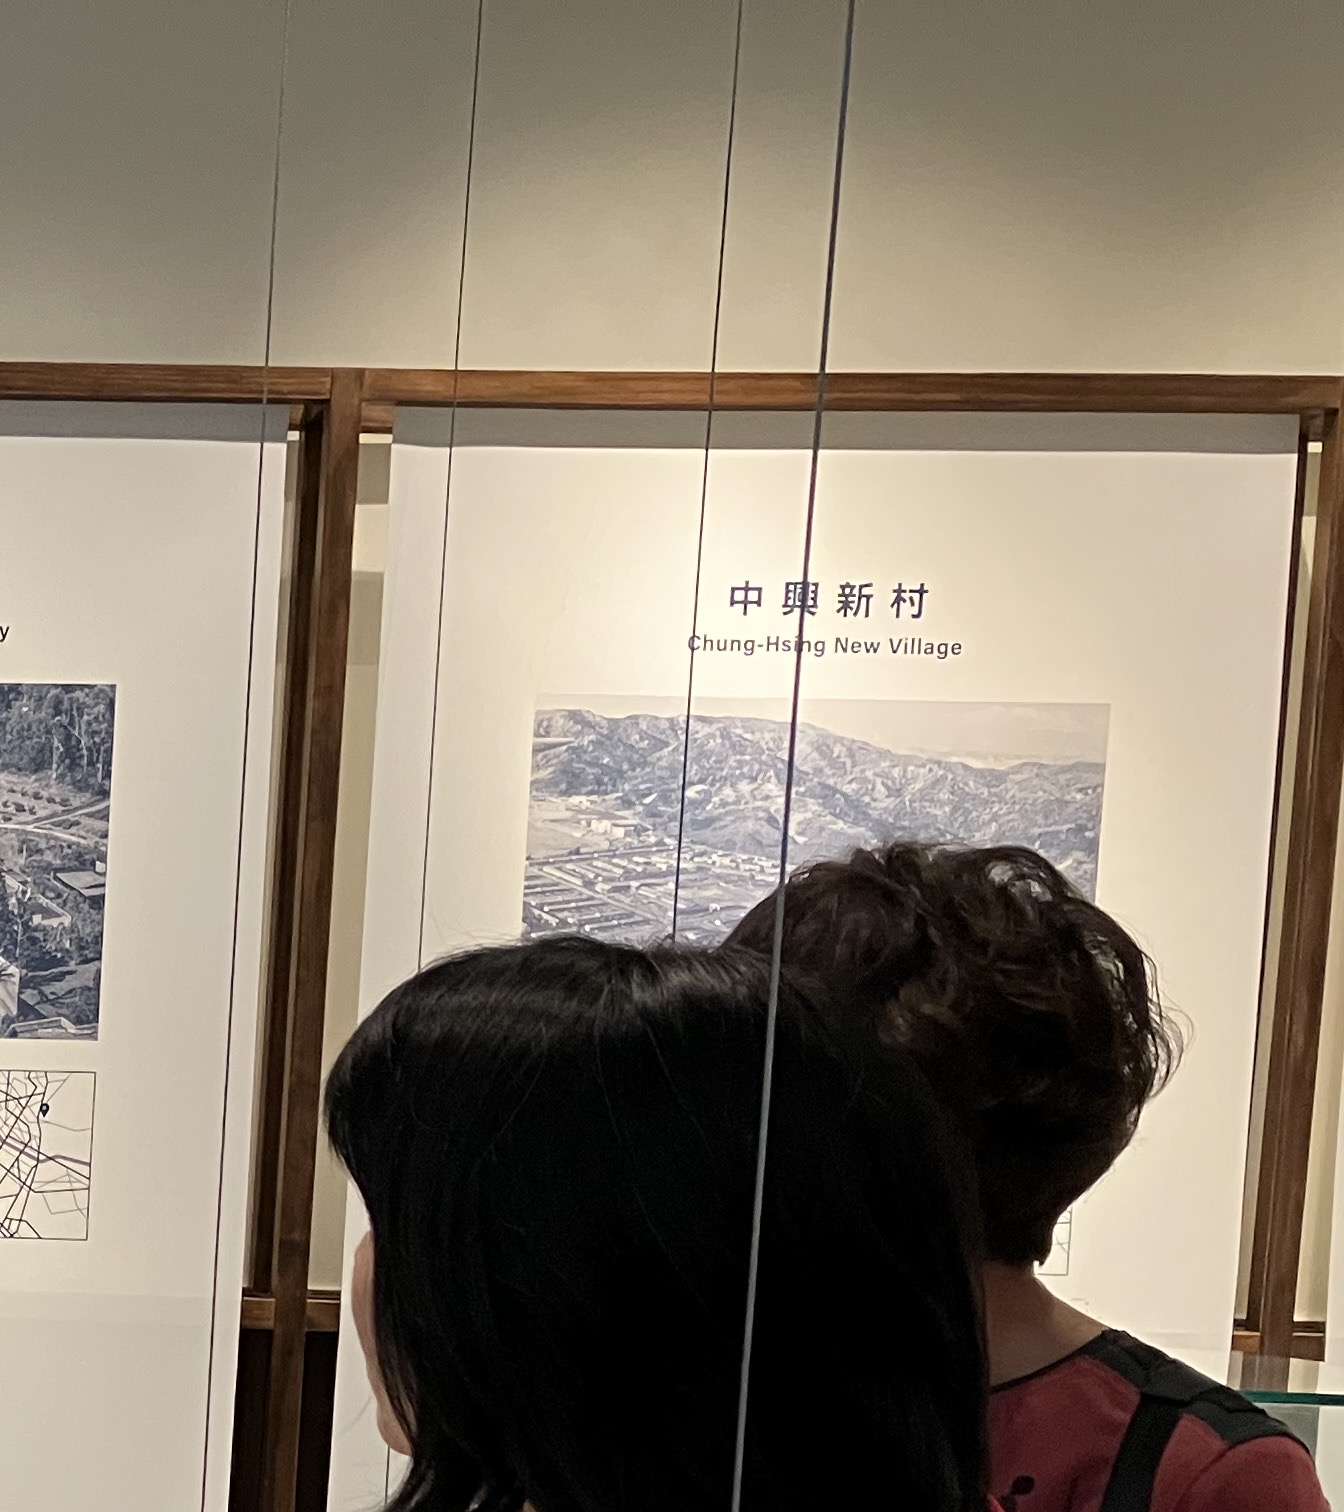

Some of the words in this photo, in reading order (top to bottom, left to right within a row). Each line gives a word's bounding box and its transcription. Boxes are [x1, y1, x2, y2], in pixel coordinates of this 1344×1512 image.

[730, 581, 928, 618] 中興新村
[688, 634, 825, 656] Chung-Hsing
[835, 637, 880, 654] New
[889, 638, 962, 659] Village
